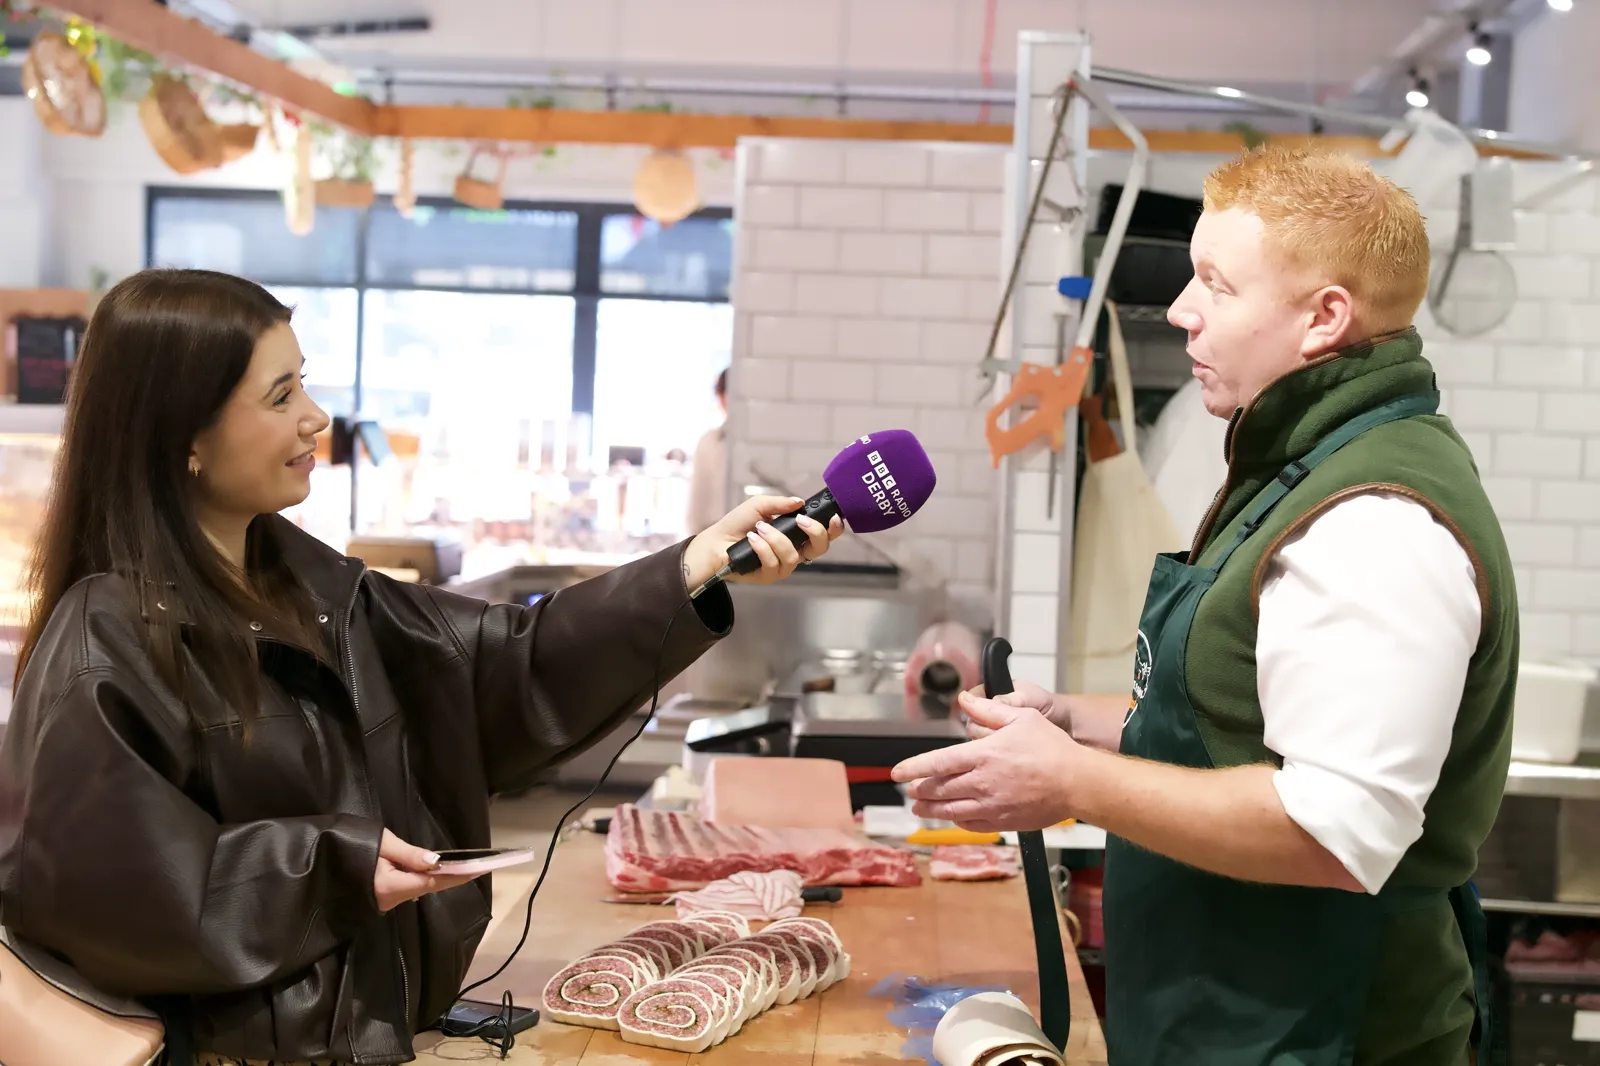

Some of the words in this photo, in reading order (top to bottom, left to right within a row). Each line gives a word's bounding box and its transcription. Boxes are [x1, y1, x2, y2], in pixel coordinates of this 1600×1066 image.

[861, 471, 896, 516] DERBY
[867, 450, 896, 490] BBC
[891, 488, 912, 518] RADIO
